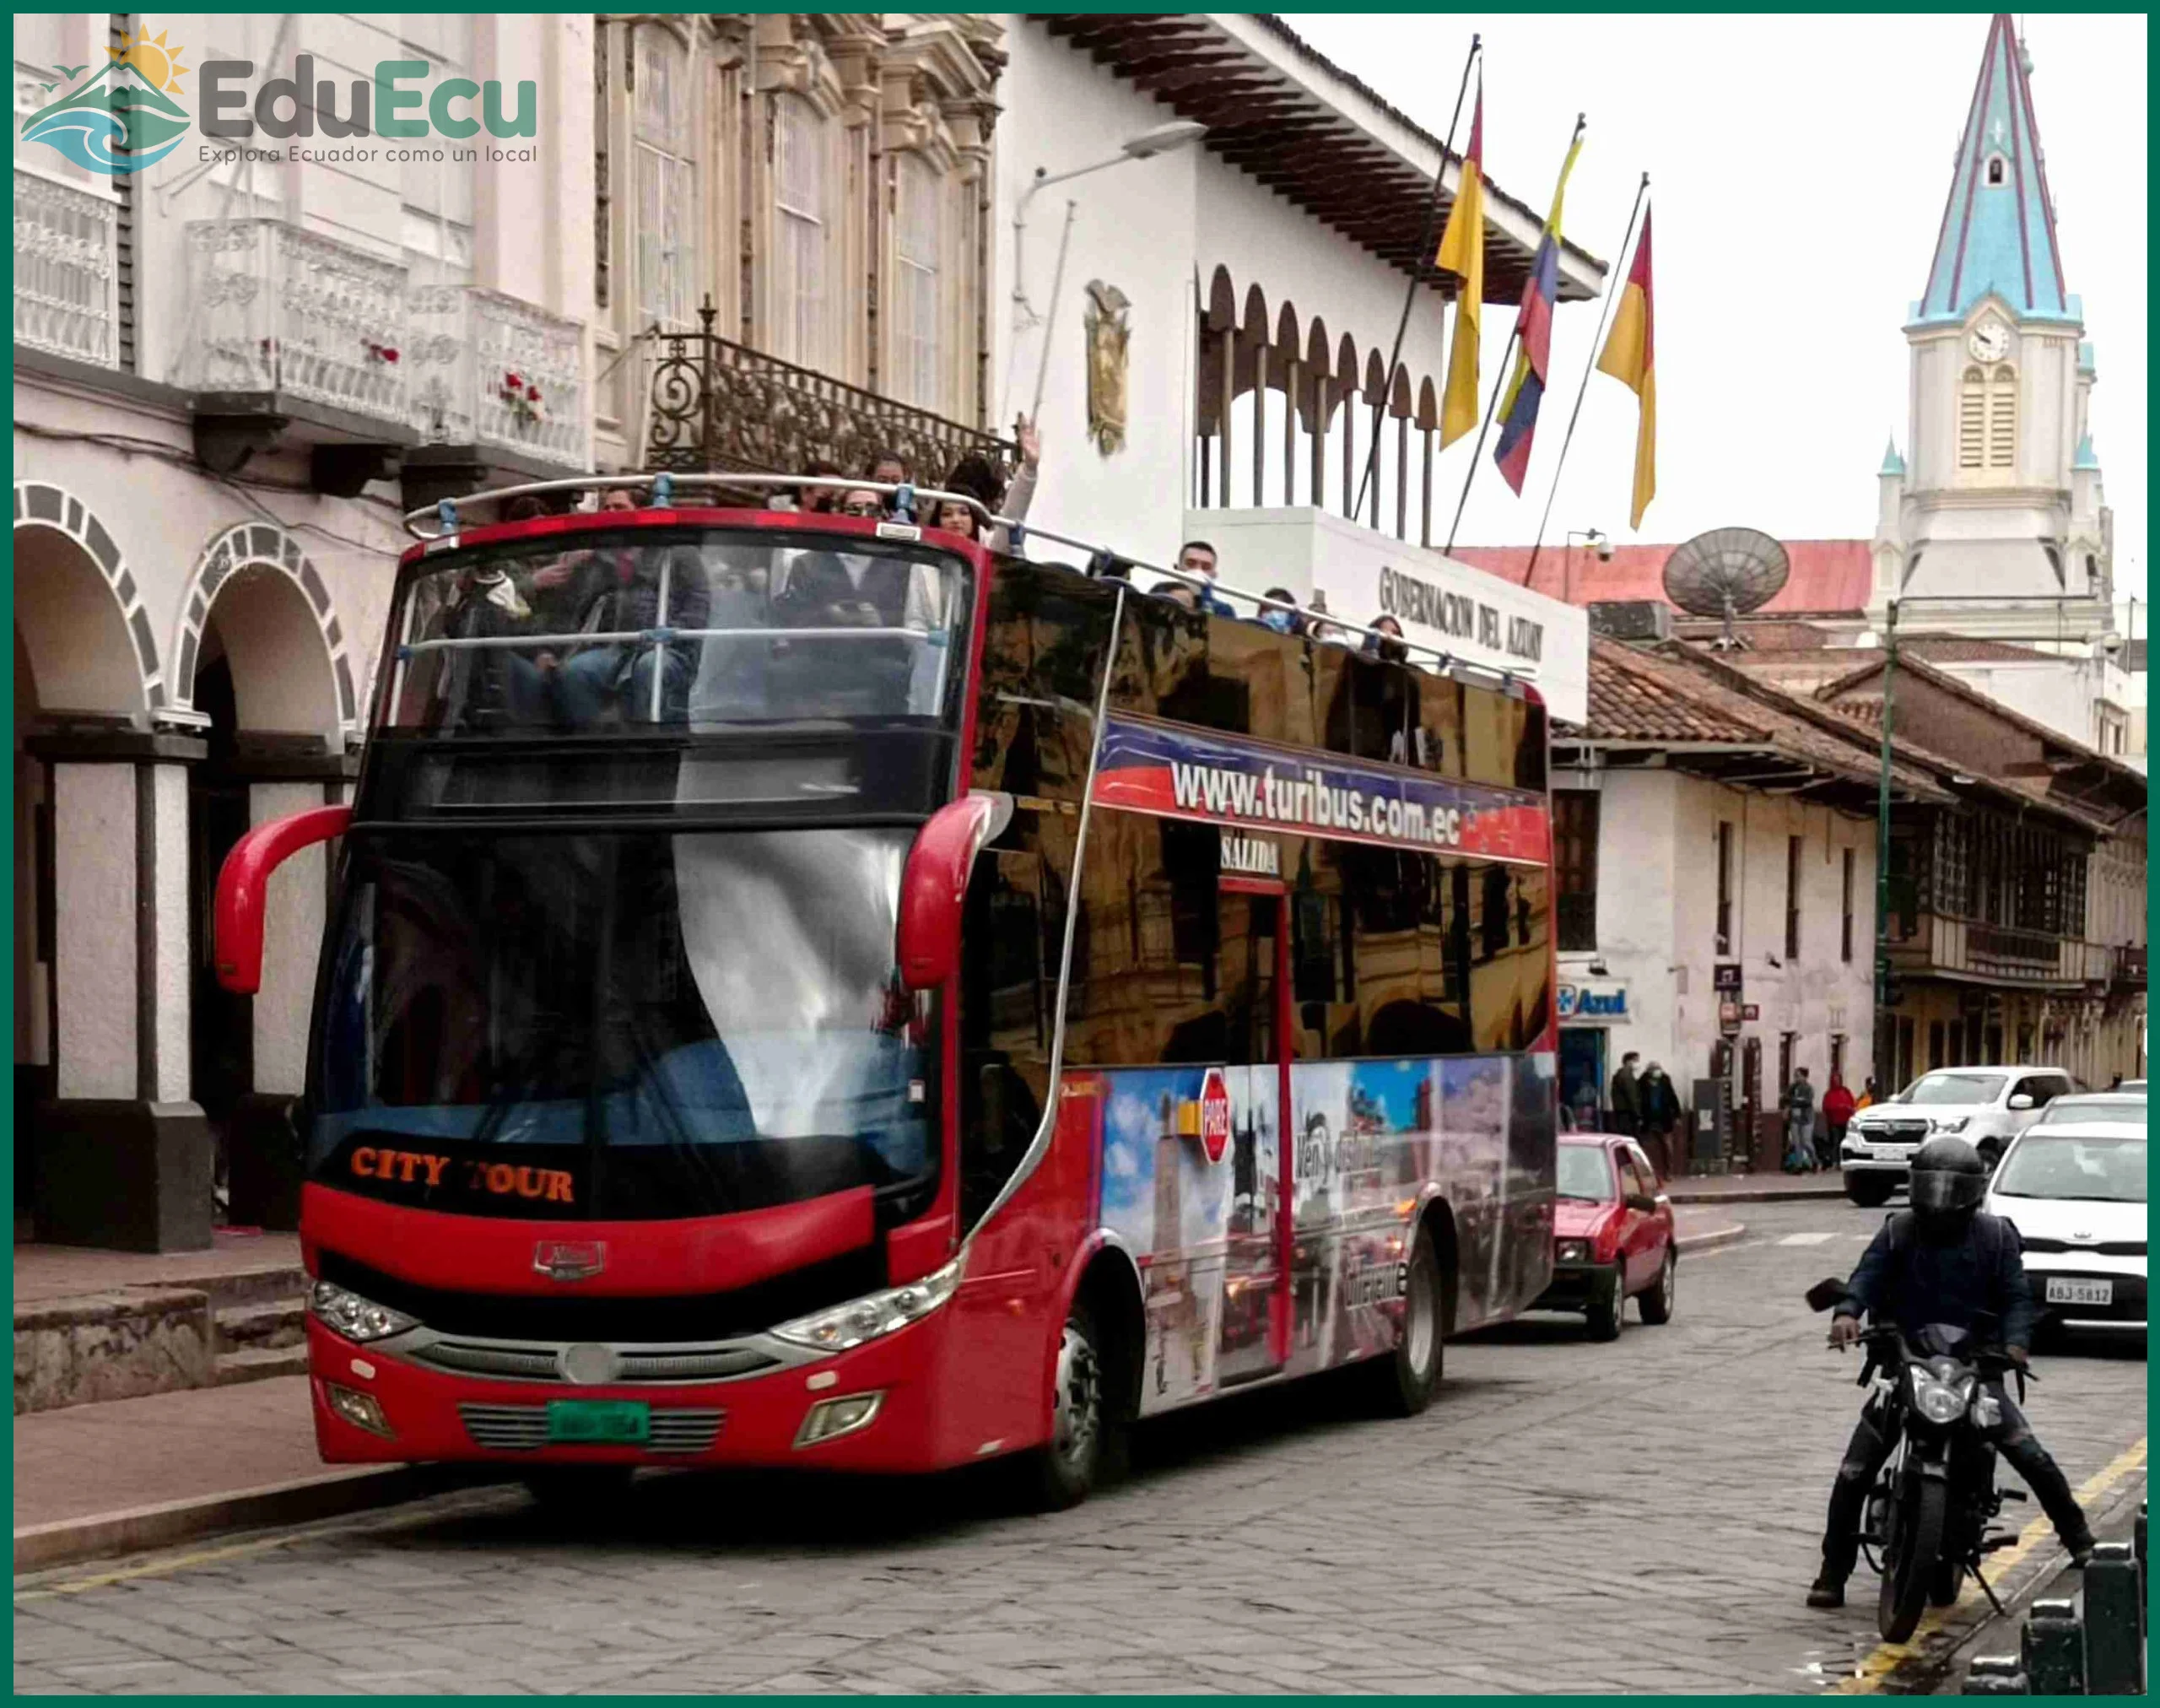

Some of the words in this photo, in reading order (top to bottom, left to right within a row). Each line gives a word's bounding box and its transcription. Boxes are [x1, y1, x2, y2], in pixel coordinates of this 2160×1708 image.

[1477, 603, 1502, 651] DEL
[1220, 835, 1279, 875] SALIDA
[1578, 988, 1627, 1013] Azul
[1204, 1098, 1227, 1136] PARE
[351, 1147, 451, 1186] CITY
